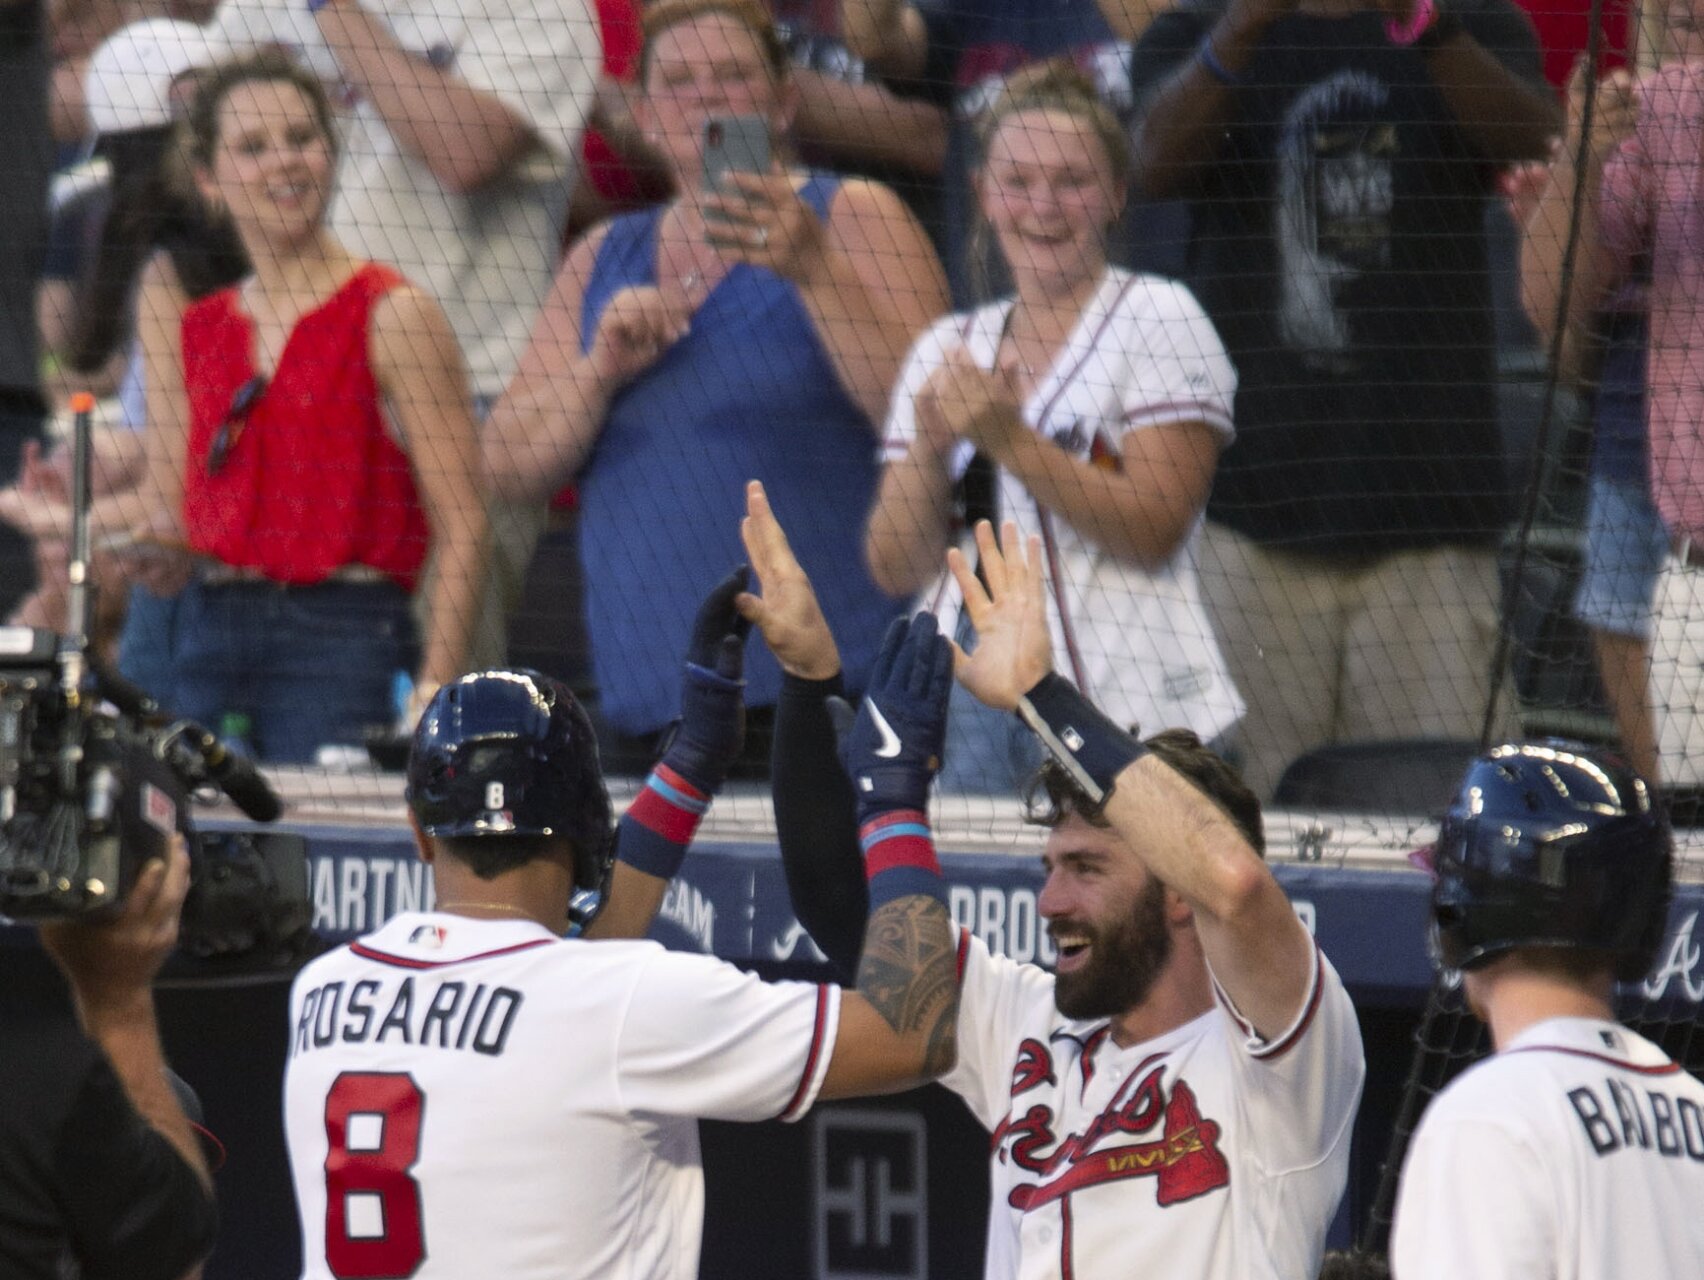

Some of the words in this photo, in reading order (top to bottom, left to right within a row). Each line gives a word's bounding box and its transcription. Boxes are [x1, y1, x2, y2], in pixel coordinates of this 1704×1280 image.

[485, 782, 504, 810] 8
[306, 857, 436, 931] ARTN
[294, 976, 525, 1057] ROSARIO
